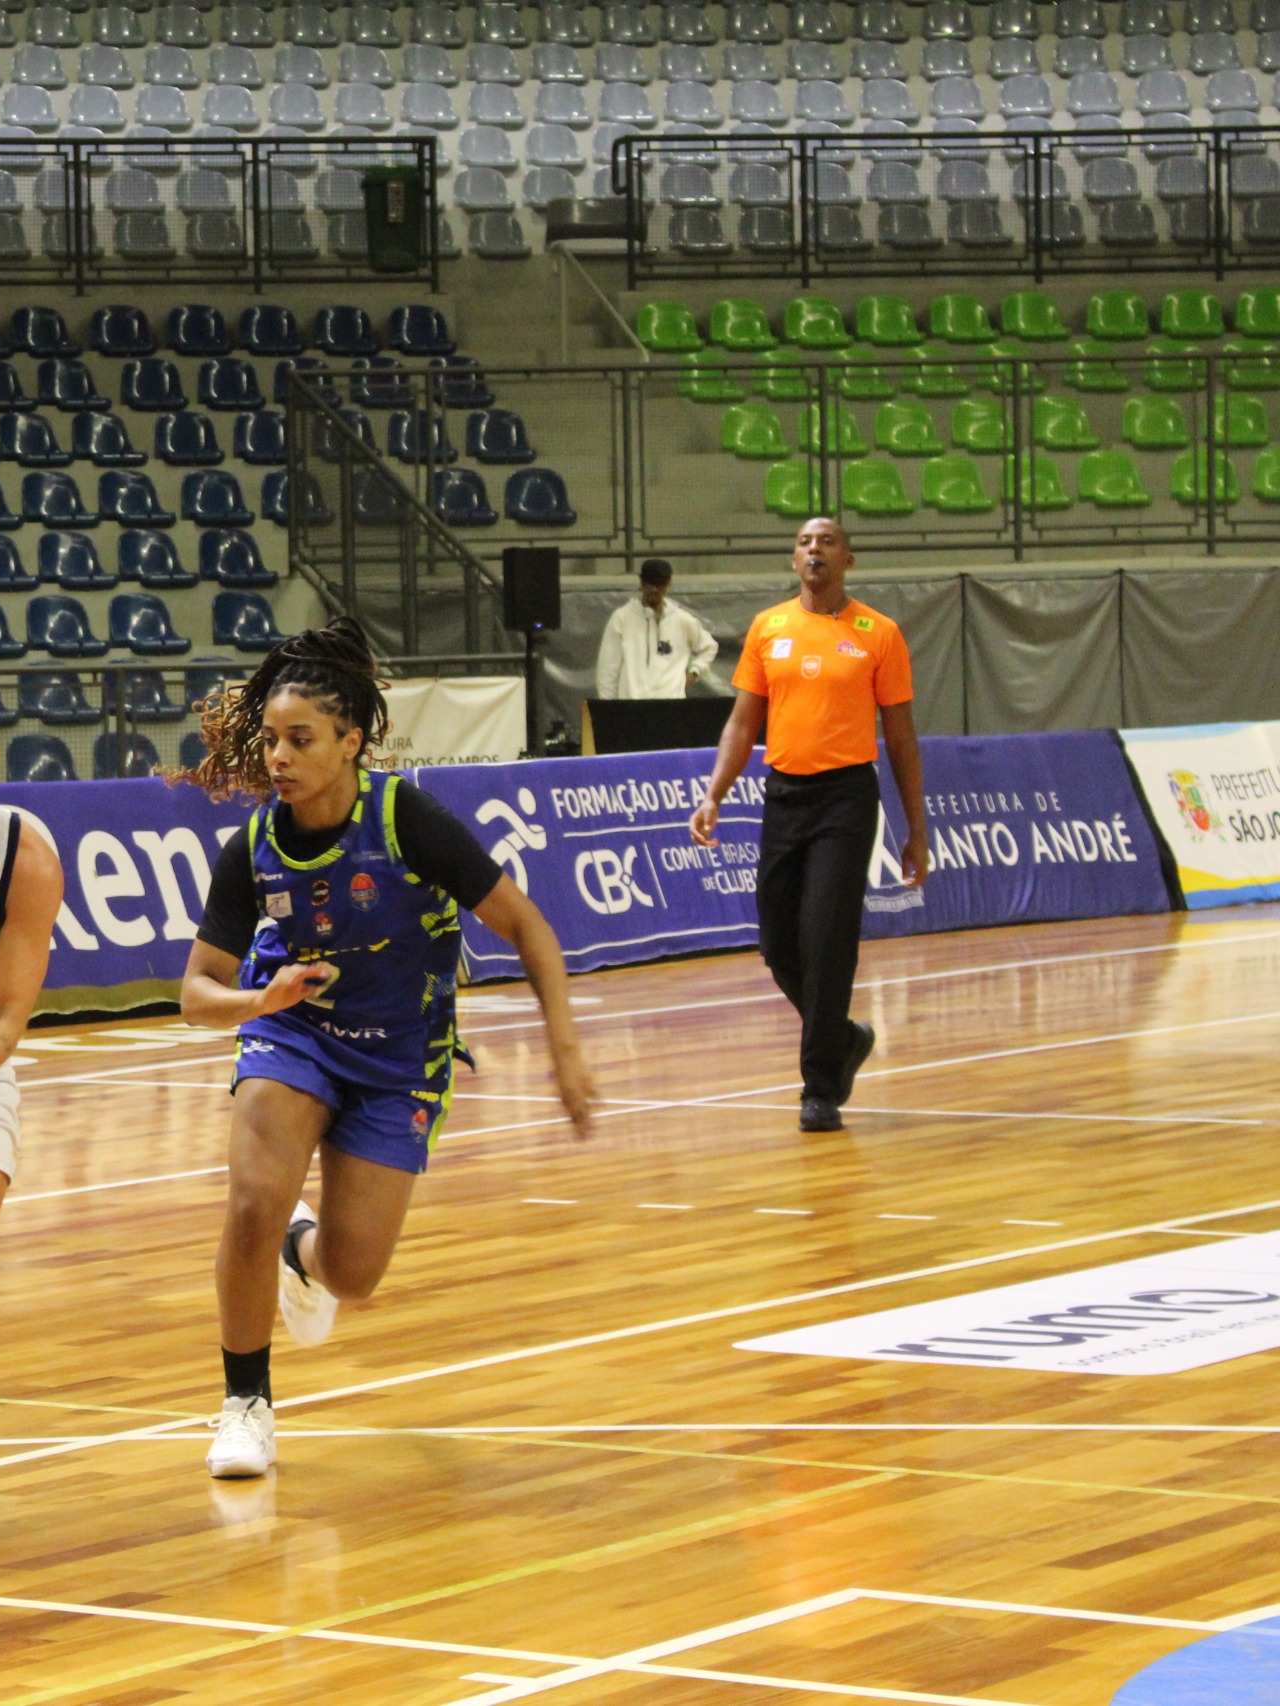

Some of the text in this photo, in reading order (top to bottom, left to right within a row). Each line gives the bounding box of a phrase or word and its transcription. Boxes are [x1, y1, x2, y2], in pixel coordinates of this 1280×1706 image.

[551, 777, 659, 822] FORMAÇÃO
[659, 778, 692, 810] DE
[924, 791, 1062, 816] EFEITURA DE
[1031, 813, 1137, 864] ANDRÉ
[1229, 808, 1266, 843] SÃO
[575, 845, 654, 915] CBC
[870, 1288, 1280, 1361] rumo
